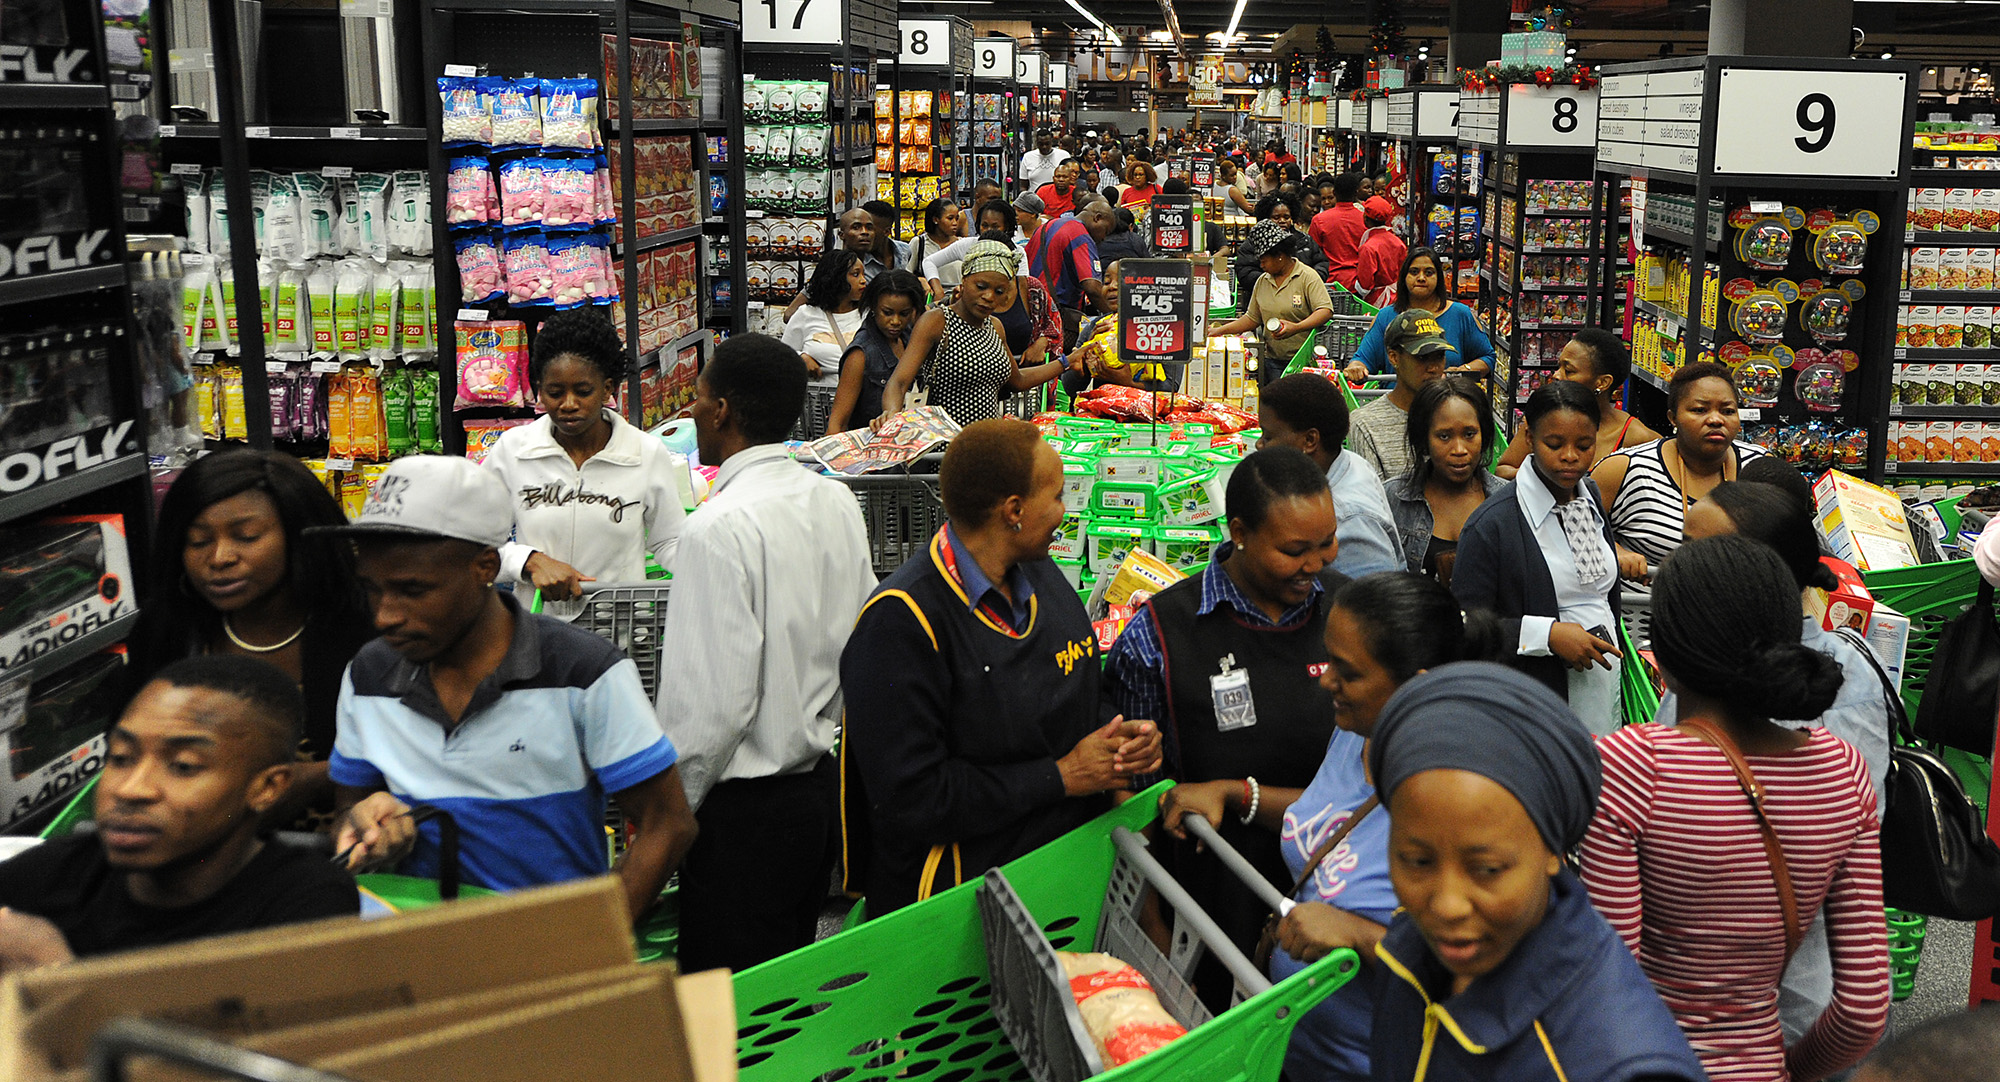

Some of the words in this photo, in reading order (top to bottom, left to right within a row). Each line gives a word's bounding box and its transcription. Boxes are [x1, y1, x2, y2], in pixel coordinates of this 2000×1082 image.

[760, 0, 811, 29] 17
[1018, 58, 1028, 77] 0
[1195, 66, 1217, 84] 50
[1195, 83, 1217, 91] WINES
[1551, 96, 1579, 133] 8
[1679, 99, 1699, 118] vinegar
[1794, 92, 1837, 154] 9
[1660, 124, 1673, 139] salad
[1674, 125, 1696, 144] dressing
[1325, 146, 1336, 177] ORE
[1679, 150, 1695, 166] olives
[1159, 214, 1183, 226] R40
[1161, 231, 1183, 240] 40%
[1161, 238, 1183, 247] OFF
[1124, 276, 1155, 285] BLACK
[1155, 276, 1188, 285] FRIDAY
[1131, 294, 1173, 314] R45
[278, 321, 291, 329] 20
[374, 326, 386, 335] 20
[407, 326, 421, 335] 20
[1136, 323, 1174, 338] 30%
[316, 332, 330, 341] 20
[344, 332, 356, 341] 20
[1135, 336, 1174, 351] OFF
[0, 419, 135, 493] OFLY
[522, 481, 641, 524] Billabong
[1190, 509, 1212, 521] ARIEL
[1048, 544, 1072, 553] ARIEL
[1223, 691, 1243, 705] 039
